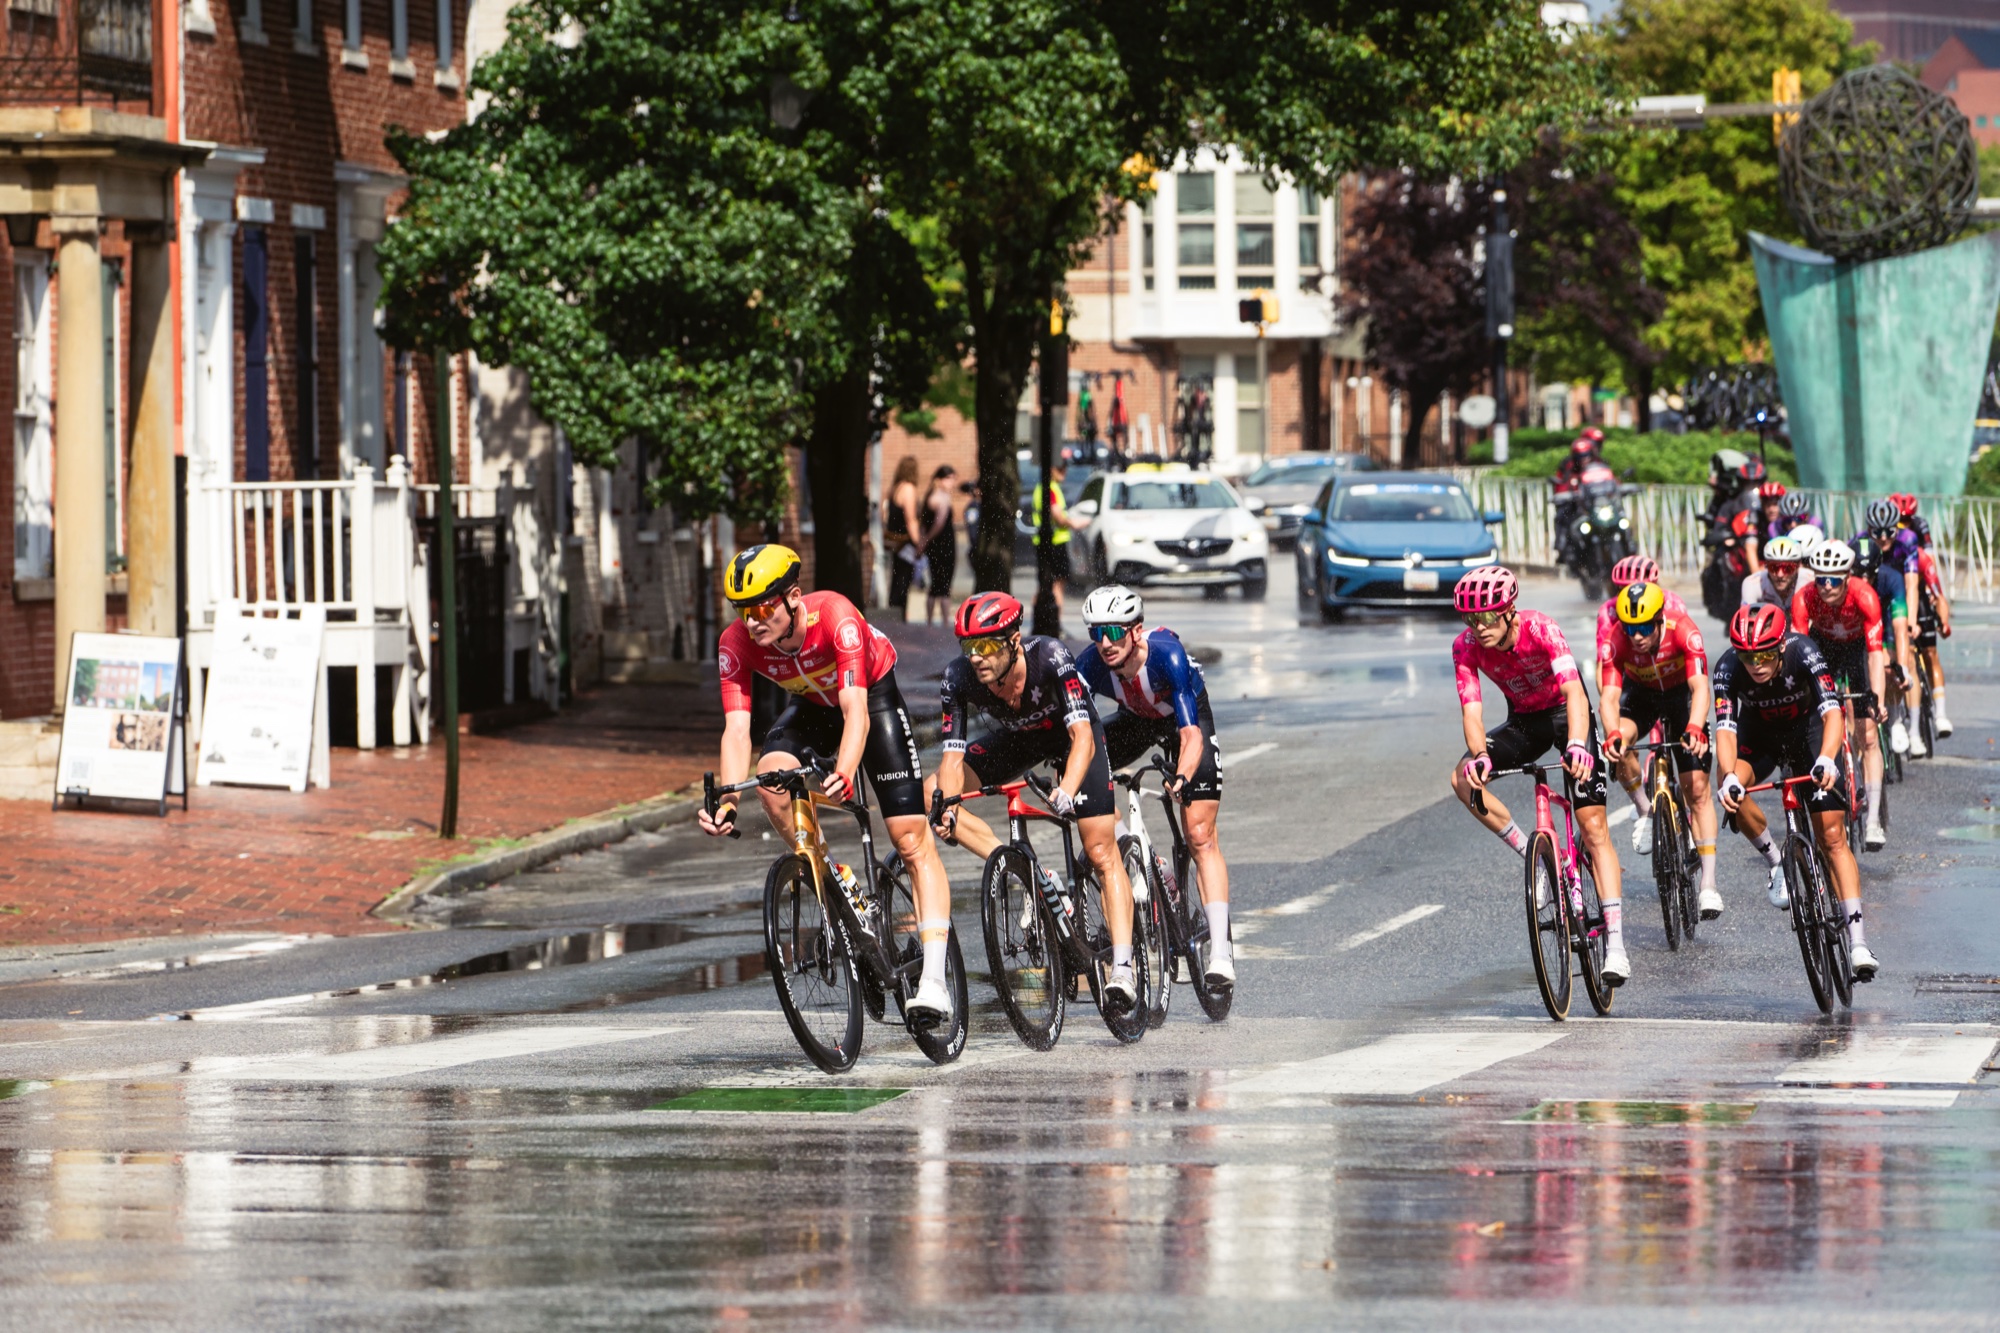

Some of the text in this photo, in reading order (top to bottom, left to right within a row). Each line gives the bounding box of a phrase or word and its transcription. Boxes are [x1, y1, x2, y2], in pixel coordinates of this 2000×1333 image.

[841, 623, 860, 648] R
[1049, 648, 1072, 665] MSC
[1802, 651, 1823, 666] MSC
[940, 679, 956, 691] SC
[947, 741, 965, 750] BOSS
[907, 738, 922, 780] REMA
[876, 769, 909, 782] FUSION
[822, 855, 877, 938] RIDLEY
[1036, 861, 1071, 938] BMC
[836, 918, 860, 983] DT SWISS
